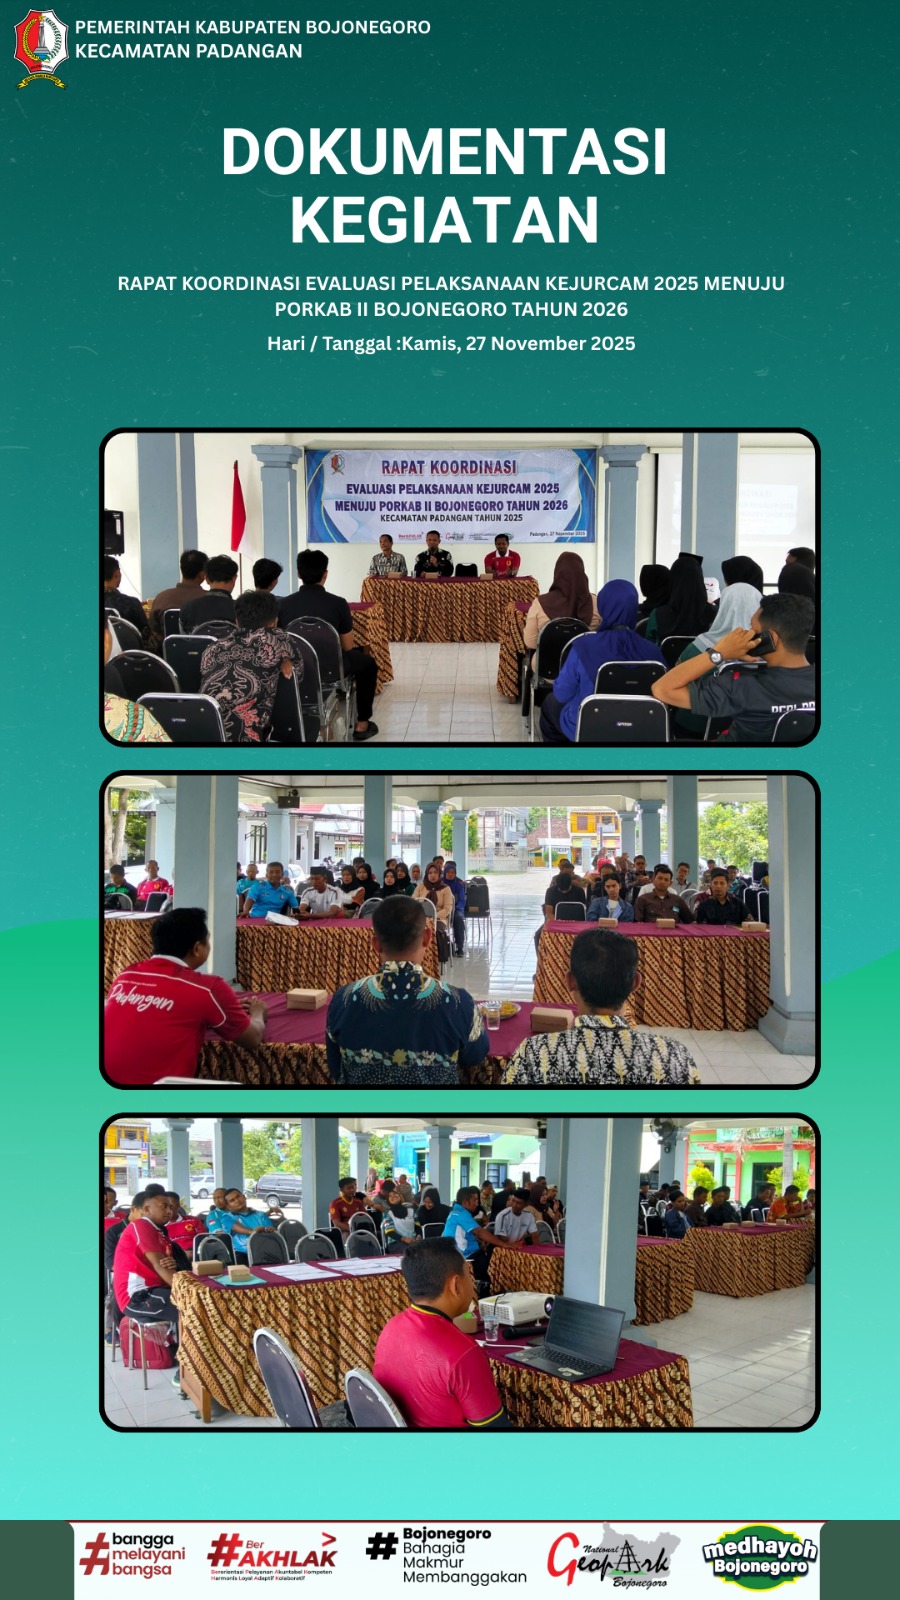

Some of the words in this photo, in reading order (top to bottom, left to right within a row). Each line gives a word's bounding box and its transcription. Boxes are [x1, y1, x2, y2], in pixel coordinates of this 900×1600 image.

[381, 460, 425, 475] RAPAT
[430, 459, 517, 475] KOORDINASI
[346, 484, 396, 495] EVALUASI
[398, 484, 474, 495] PELAKSANAAN
[476, 483, 531, 494] KEJURCAM
[534, 483, 560, 494] 2025
[335, 501, 377, 512] MENUJU
[379, 501, 422, 512] PORKAB
[424, 500, 432, 512] II
[434, 500, 504, 512] BOJONEGORO
[506, 500, 540, 511] TAHUN
[542, 500, 568, 511] 2026
[380, 514, 428, 522] KECAMATAN
[429, 514, 473, 522] PADANGAN
[475, 514, 502, 522] TAHUN
[503, 513, 523, 522] 2025
[107, 983, 174, 1012] Padangan
